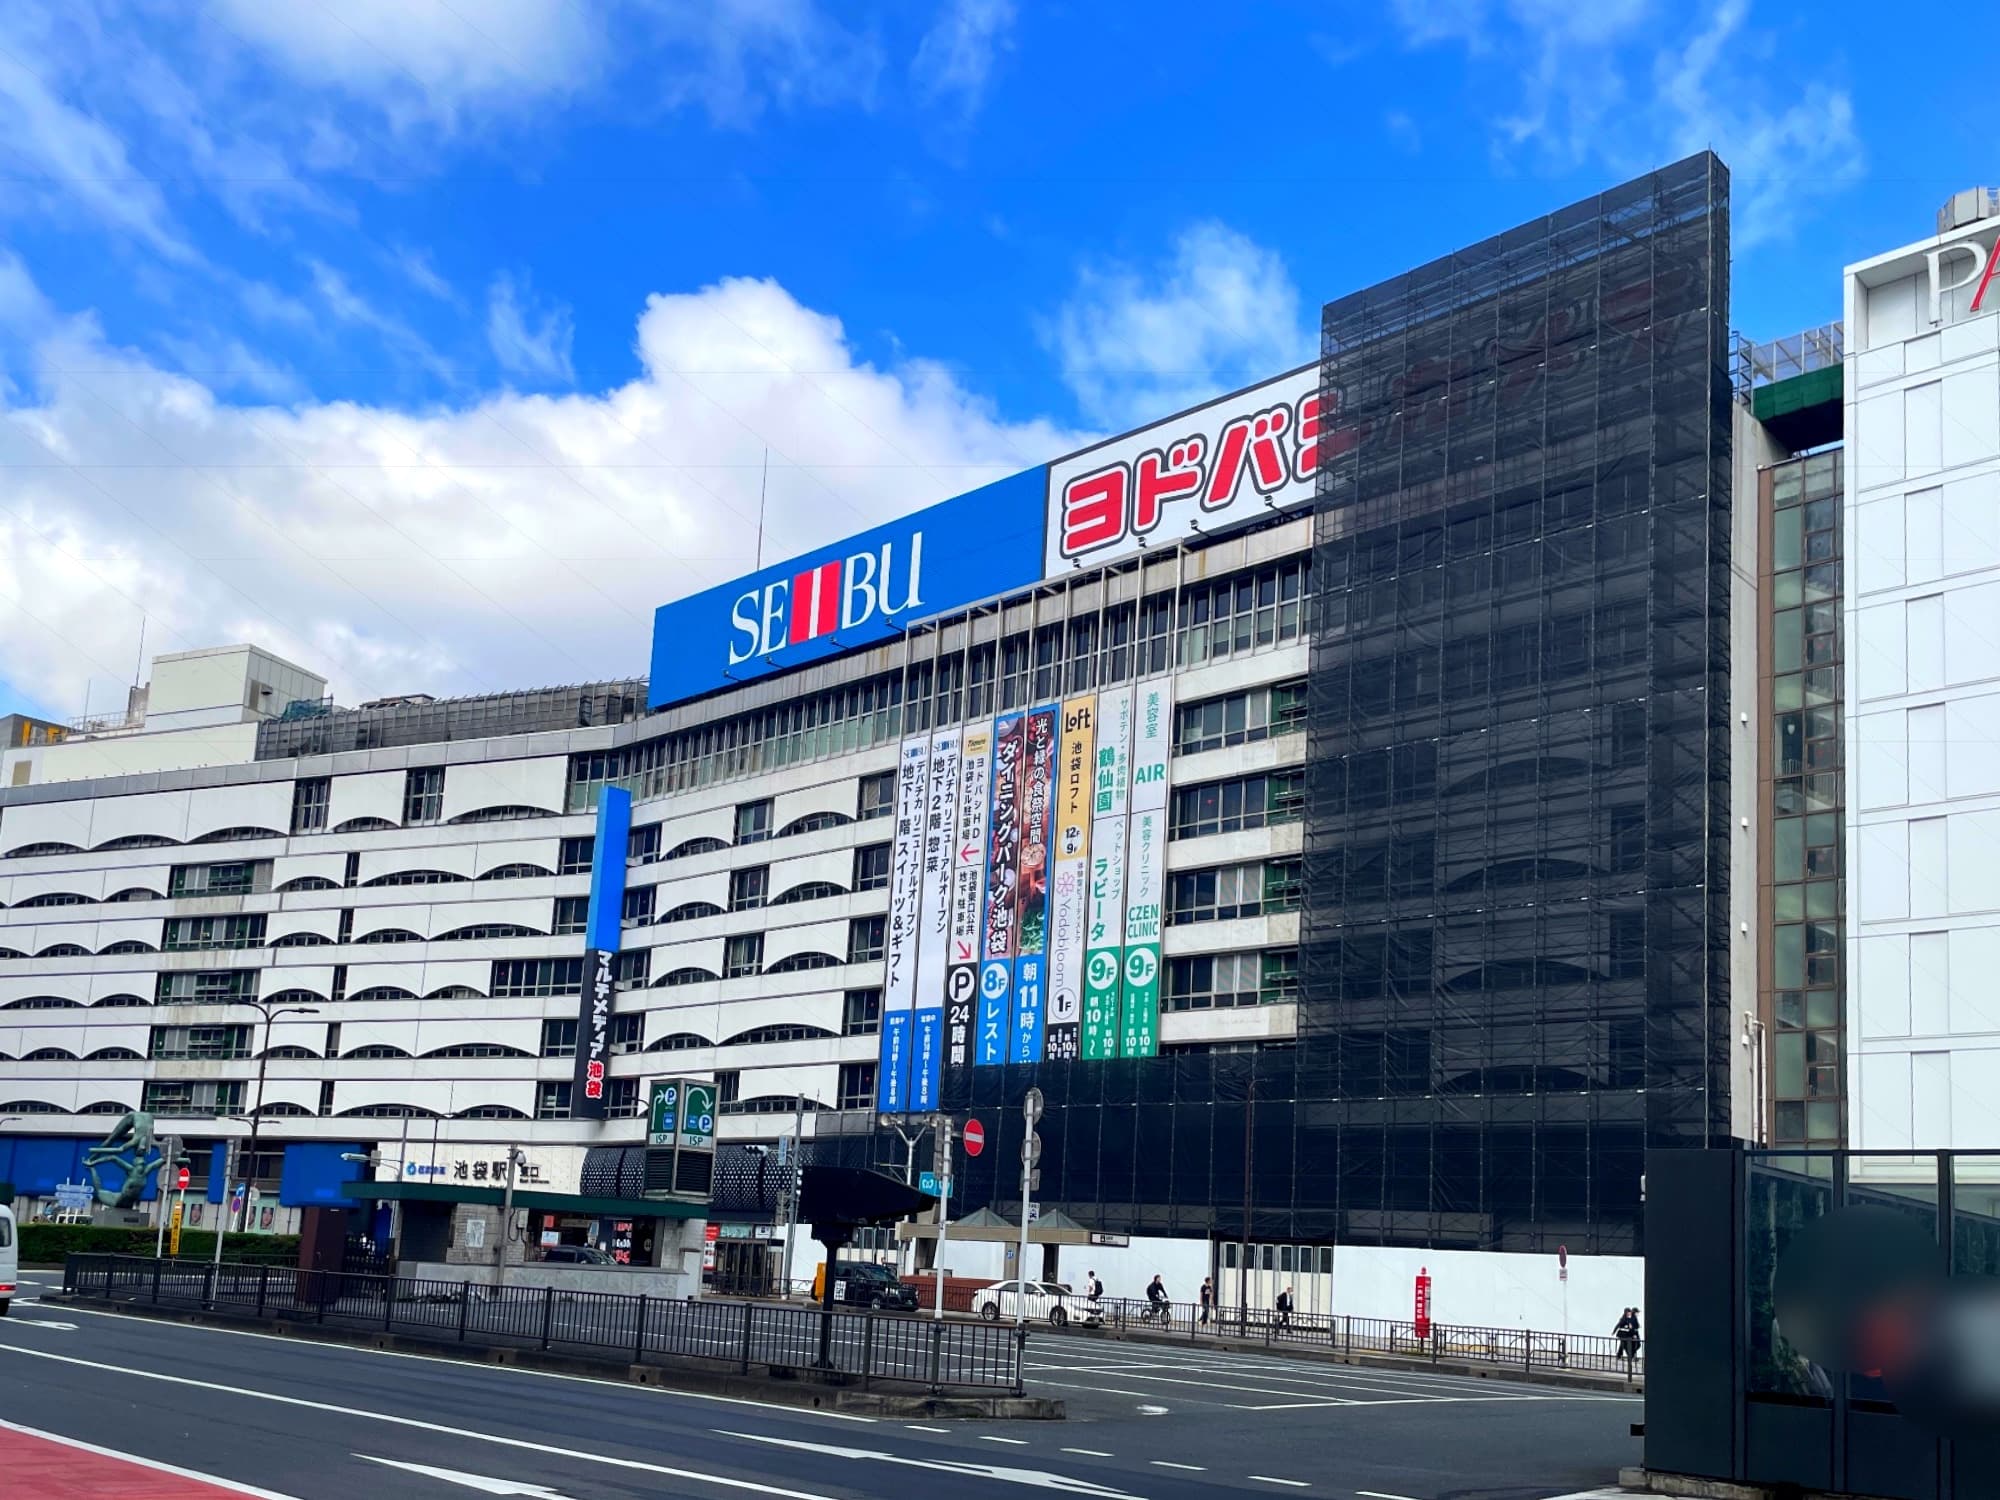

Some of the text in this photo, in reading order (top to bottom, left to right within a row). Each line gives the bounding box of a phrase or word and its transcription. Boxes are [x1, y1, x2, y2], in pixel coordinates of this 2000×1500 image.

[729, 531, 926, 666] SEIBU
[1146, 691, 1159, 738] 美容室
[899, 763, 915, 837] 地下1階
[929, 757, 945, 831] 地下2階
[1070, 741, 1082, 814] 池袋ロフト
[1096, 745, 1115, 813] 鶴仙園
[1135, 763, 1165, 785] AIR
[991, 739, 1018, 954] ダイニングパーク池袋
[1140, 815, 1152, 898] 美容クリニック
[1091, 858, 1108, 941] ラビータ
[1128, 904, 1159, 922] CZEN
[1055, 898, 1071, 988] Yodobloom
[1127, 921, 1159, 939] CLINIC
[954, 972, 970, 999] P
[983, 969, 1005, 992] 8F
[1091, 958, 1114, 982] 9F
[1129, 954, 1154, 978] 9F
[1019, 962, 1038, 1063] 朝11時から
[1057, 994, 1072, 1013] 1F
[949, 1005, 970, 1067] 24時間
[984, 1001, 1000, 1065] レスト
[656, 1134, 668, 1144] ISP
[689, 1135, 703, 1146] ISP
[454, 1160, 508, 1181] 池袋駅
